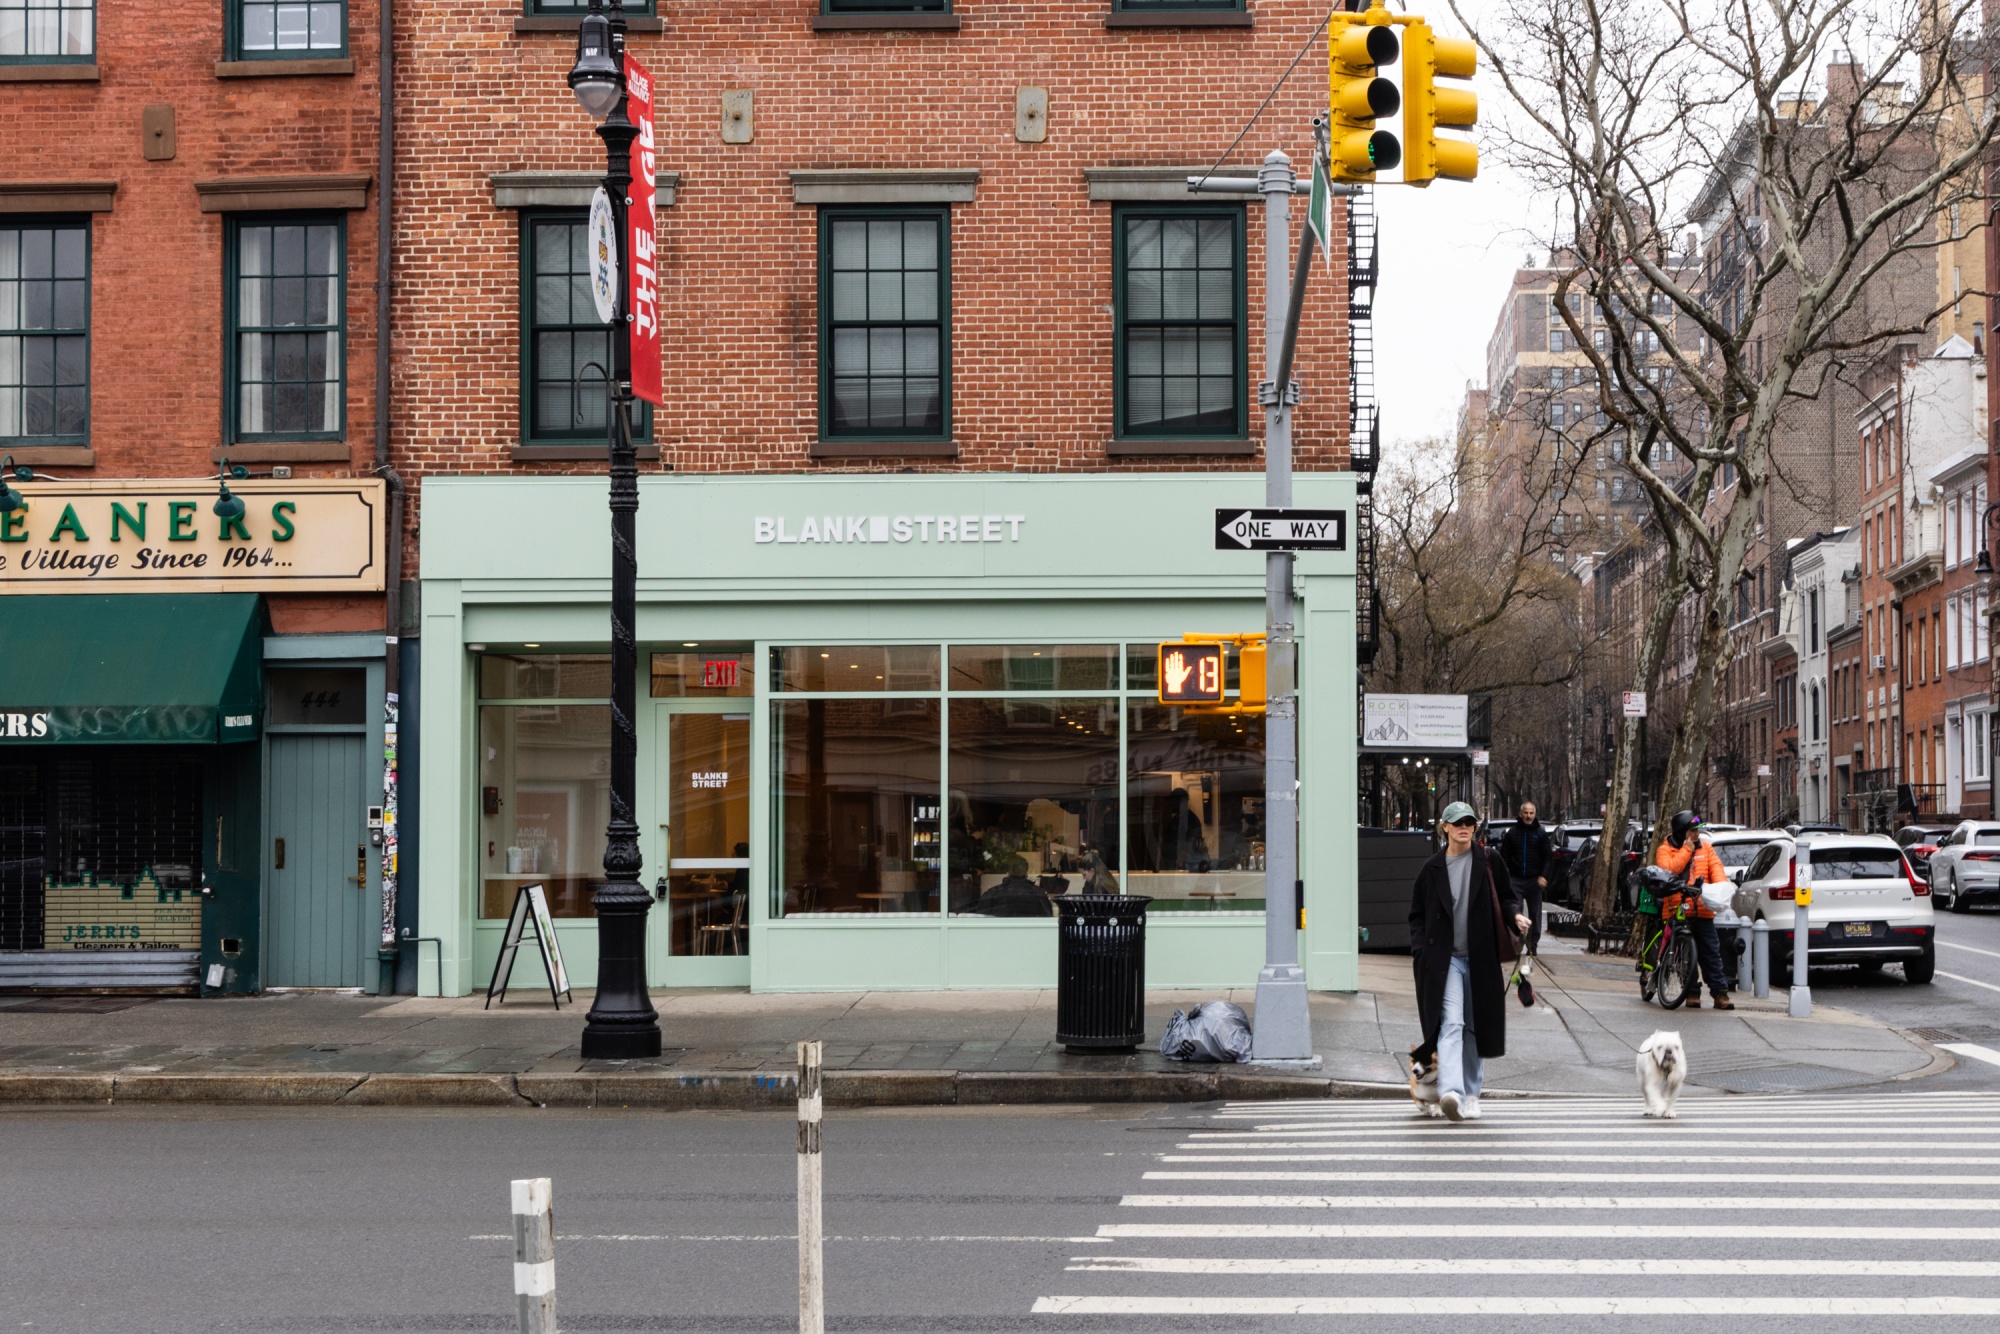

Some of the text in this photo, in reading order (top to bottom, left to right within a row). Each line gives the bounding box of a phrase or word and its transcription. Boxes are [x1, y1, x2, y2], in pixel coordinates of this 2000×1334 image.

[635, 227, 651, 336] THE
[754, 514, 1026, 543] BLANK STREET
[1235, 521, 1330, 539] ONE WAY
[20, 547, 119, 577] Village
[130, 547, 208, 570] Since
[705, 660, 739, 687] EXIT
[1198, 655, 1219, 693] 13
[300, 690, 341, 708] 444
[1368, 701, 1406, 711] ROCK
[692, 772, 721, 780] BLANK
[692, 780, 727, 788] STREET
[63, 925, 141, 942] JERRI'S
[74, 942, 123, 950] Cleaners
[140, 942, 181, 950] Tailors
